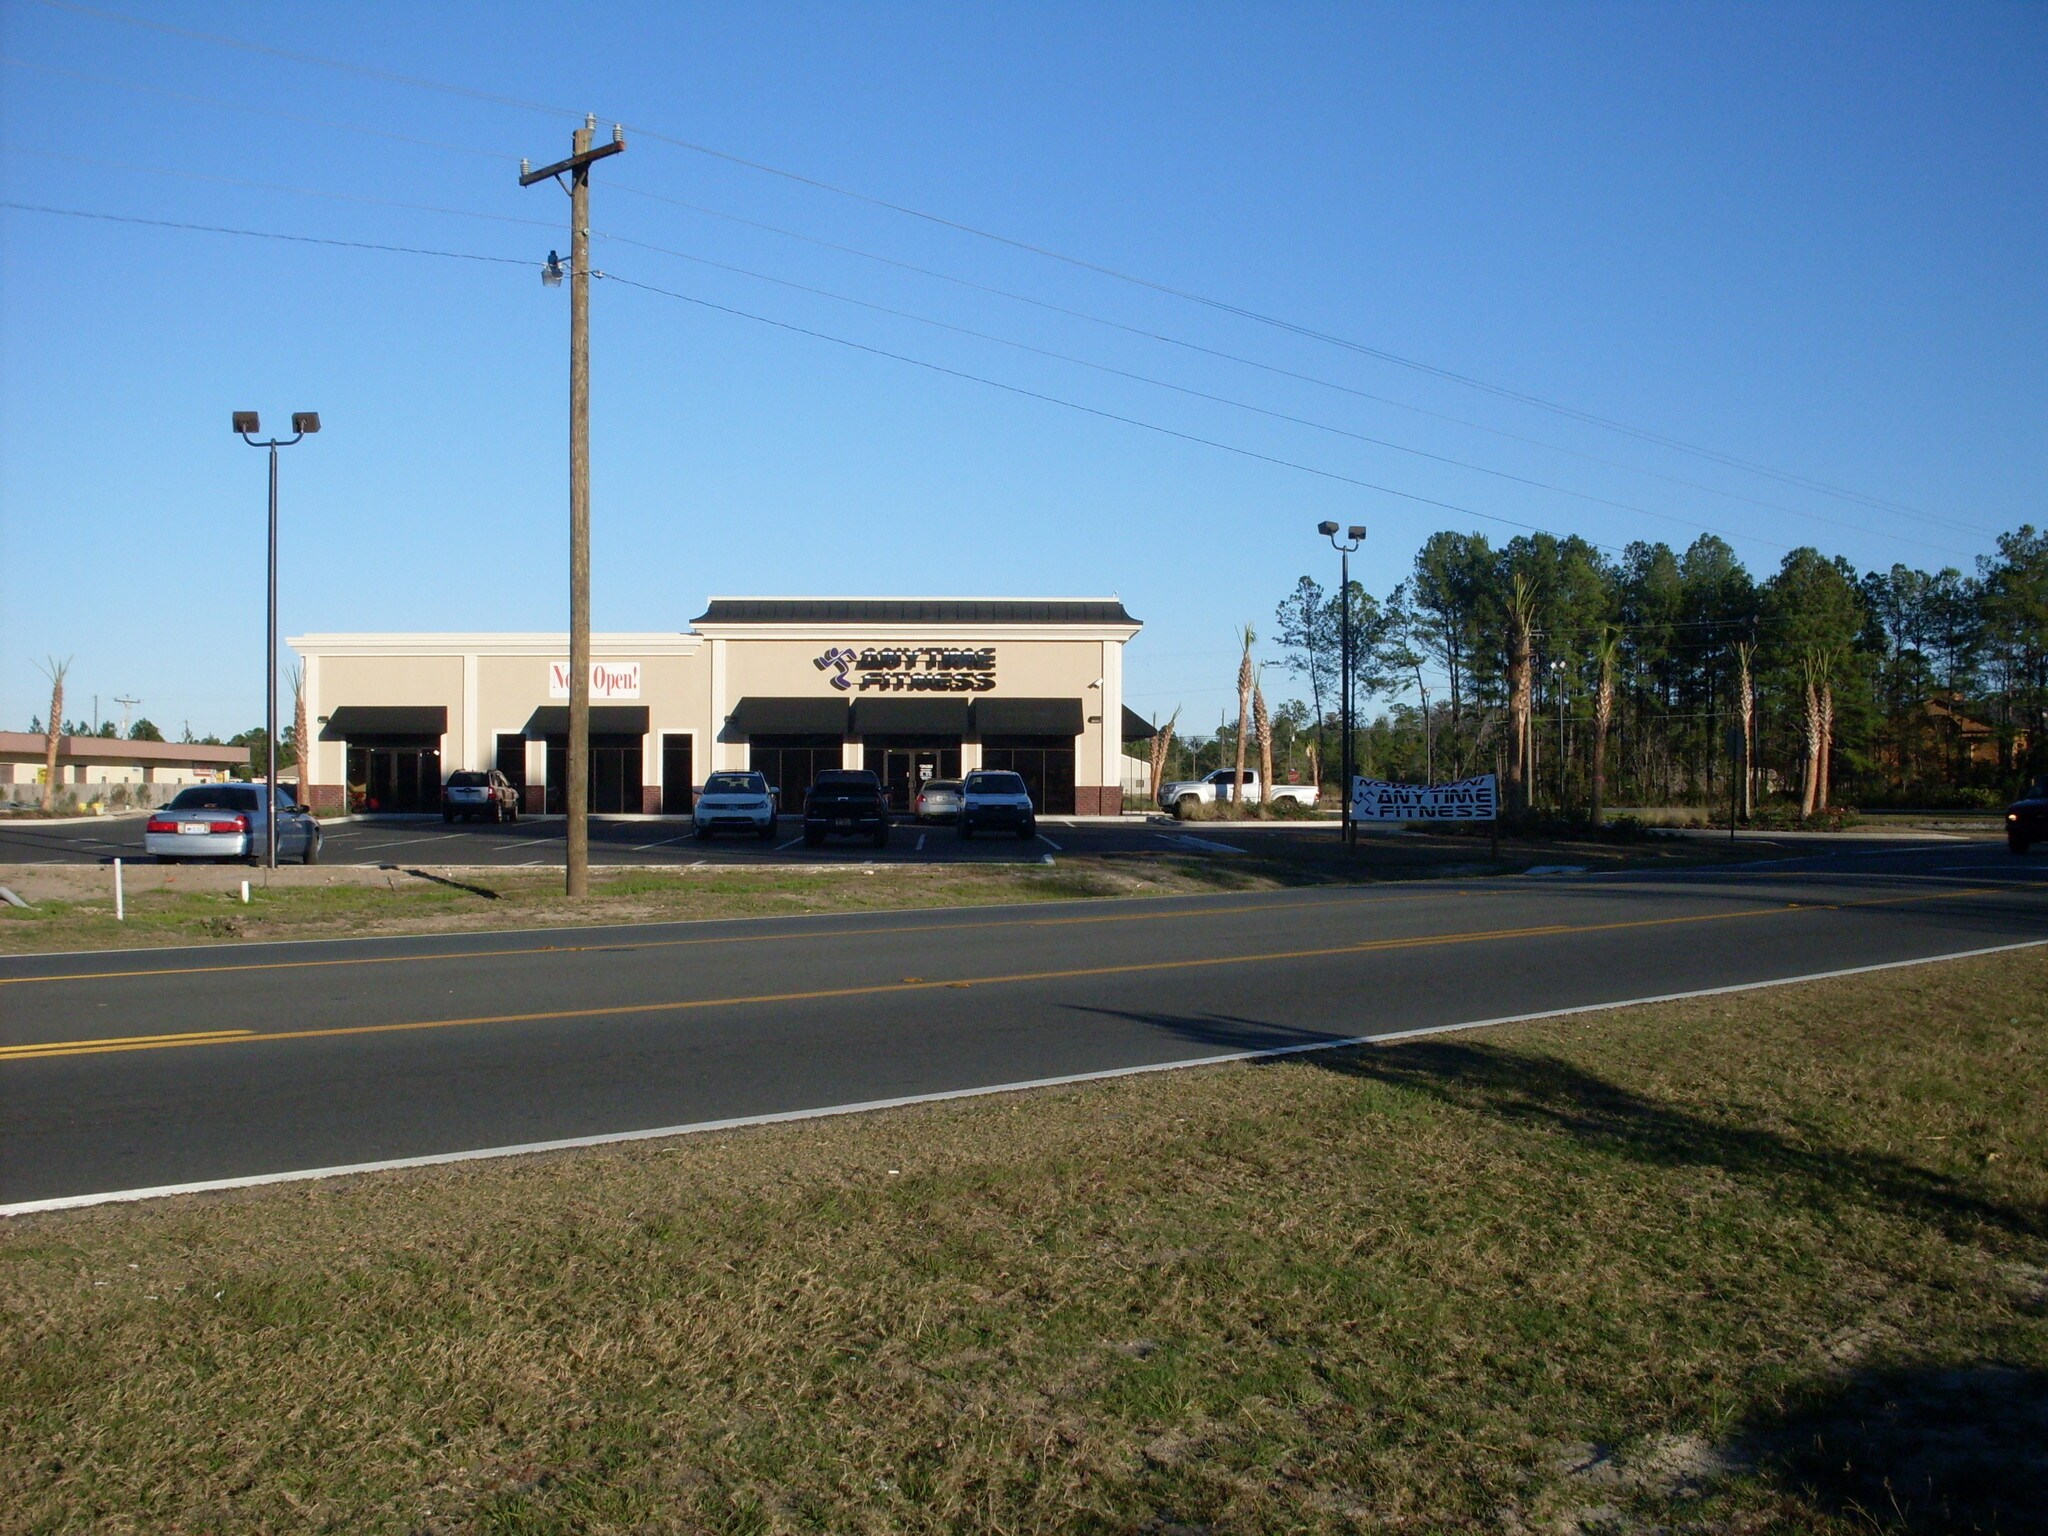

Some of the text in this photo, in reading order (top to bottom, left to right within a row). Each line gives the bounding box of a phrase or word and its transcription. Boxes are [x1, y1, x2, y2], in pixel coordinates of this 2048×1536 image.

[593, 665, 637, 696] Open!
[859, 672, 996, 692] FITNESS
[1377, 787, 1492, 804] ANYTIME
[1379, 805, 1493, 818] FITNESS
